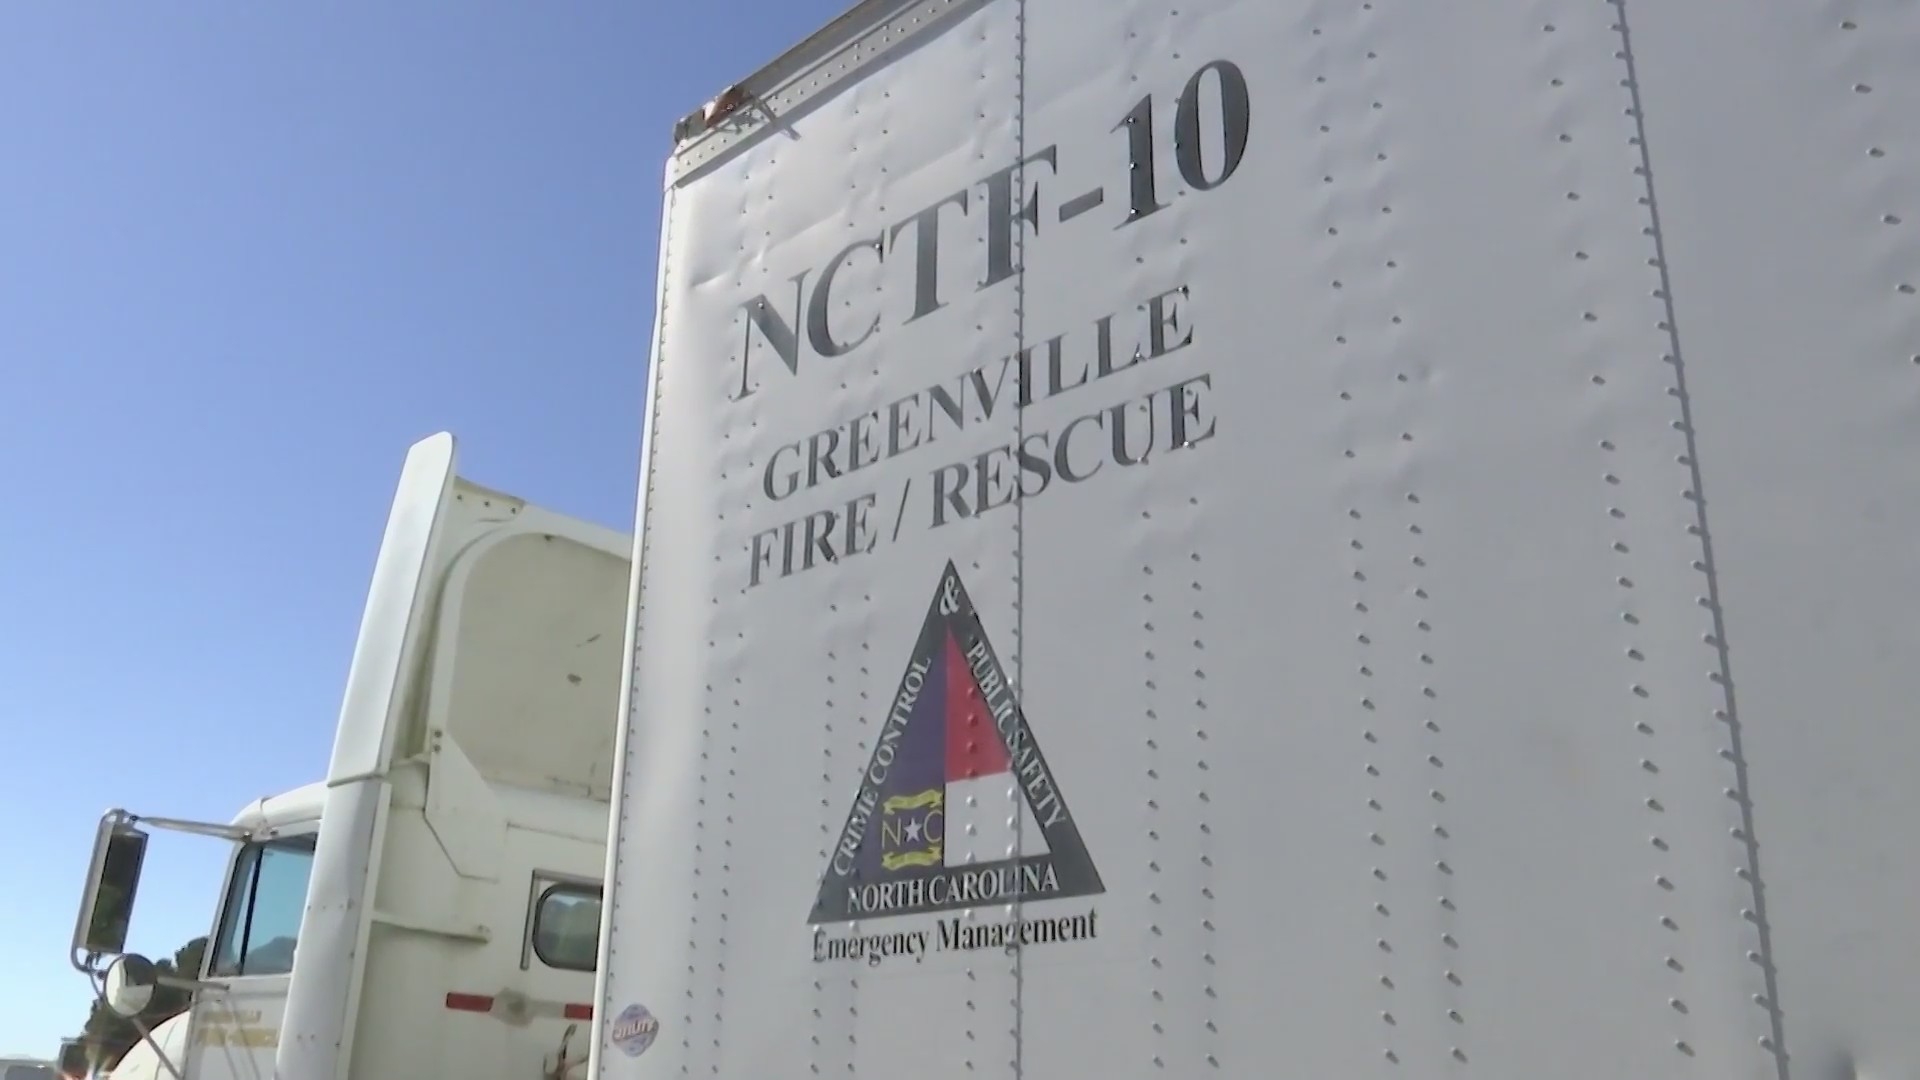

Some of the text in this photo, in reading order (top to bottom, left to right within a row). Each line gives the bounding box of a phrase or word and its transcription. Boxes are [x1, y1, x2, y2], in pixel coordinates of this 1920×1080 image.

[730, 59, 1249, 400] NCTF-10
[747, 493, 878, 589] FIRE
[928, 373, 1217, 529] RESCUE
[763, 285, 1194, 501] GREENVILLE
[938, 575, 960, 616] &
[833, 657, 931, 877] CRIME CONTROL
[966, 639, 1067, 829] PUBLIC SAFETY
[812, 906, 1098, 966] Emergency Management
[847, 862, 1060, 914] NORTH CAROLINA
